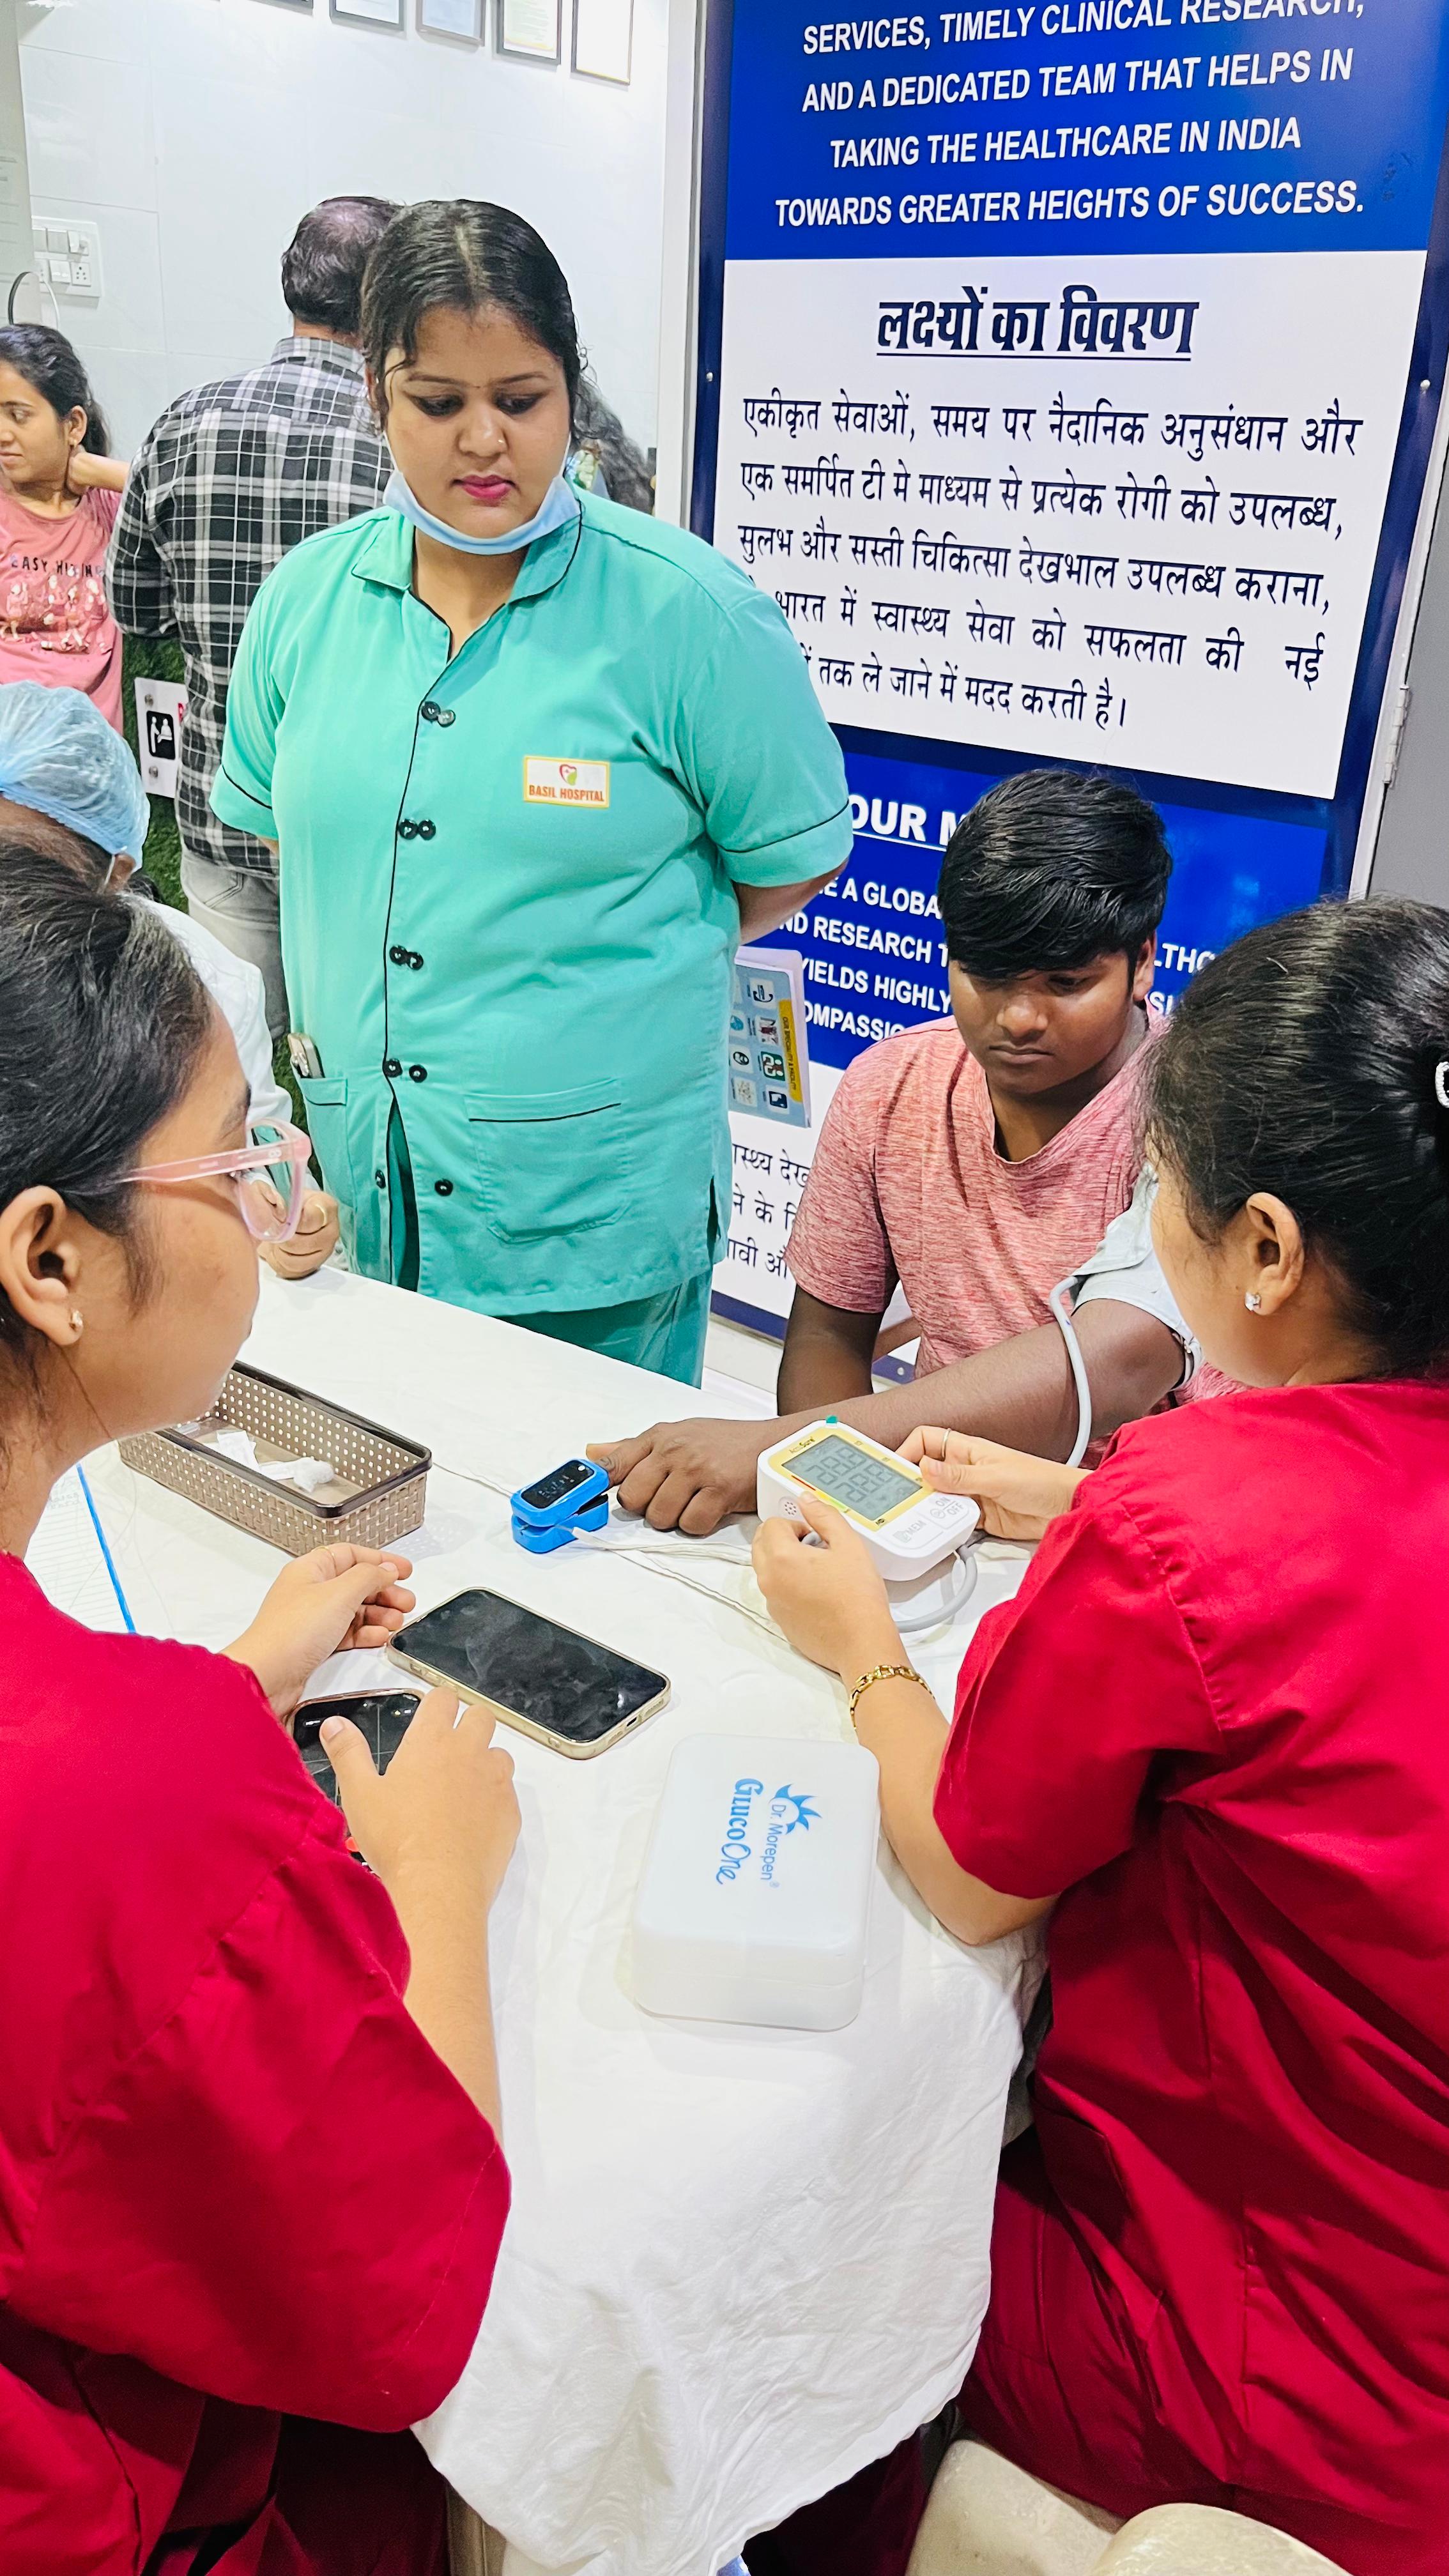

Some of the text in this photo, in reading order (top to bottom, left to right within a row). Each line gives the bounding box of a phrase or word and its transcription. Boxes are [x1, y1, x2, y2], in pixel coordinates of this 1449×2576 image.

[804, 0, 1363, 54] SERVICES, TIMELY CLINICAL RESEARCH,
[802, 48, 1353, 112] AND A DEDICATED TEAM THAT HELPS IN
[831, 118, 1300, 167] TAKING THE HEALTHCARE IN INDIA
[776, 181, 1363, 226] TOWARDS GREATER HEIGHTS OF SUCCESS.
[878, 285, 1199, 353] लक्ष्यों का विवरण
[744, 388, 1363, 461] एकीकृत सेवाओं, समय पर नैदानिक अनुसंधान और
[741, 463, 774, 500] एक
[782, 454, 854, 498] समर्पित
[862, 459, 885, 500] टी
[919, 475, 991, 507] माध्यम
[1000, 465, 1022, 510] से
[1032, 468, 1106, 515] प्रत्येक
[1116, 471, 1171, 520] रोगी
[1181, 476, 1220, 523] को
[1229, 493, 1341, 539] उपलब्ध,
[738, 516, 1328, 615] सुलभ और सस्ती चिकित्सा देखभाल उपलब्ध कराना,
[776, 586, 1324, 690] भारत में स्वास्थ्य सेवा को सफलता की नई
[819, 658, 854, 686] तक
[862, 652, 882, 691] ले
[891, 658, 932, 698] जाने
[940, 661, 958, 702] में
[965, 677, 1013, 713] मदद
[1022, 679, 1087, 720] करती
[529, 785, 604, 801] BASIL HOSPITAL
[848, 794, 926, 842] OUR
[842, 878, 857, 901] A
[864, 882, 941, 919] GLOBA
[779, 912, 808, 935] ND
[814, 917, 931, 963] RESEARCH
[873, 974, 952, 1014] HIGHLY
[804, 1000, 906, 1041] OMPASSI
[780, 1149, 810, 1187] देख
[755, 1191, 774, 1222] के
[770, 1804, 786, 1819] Dr.
